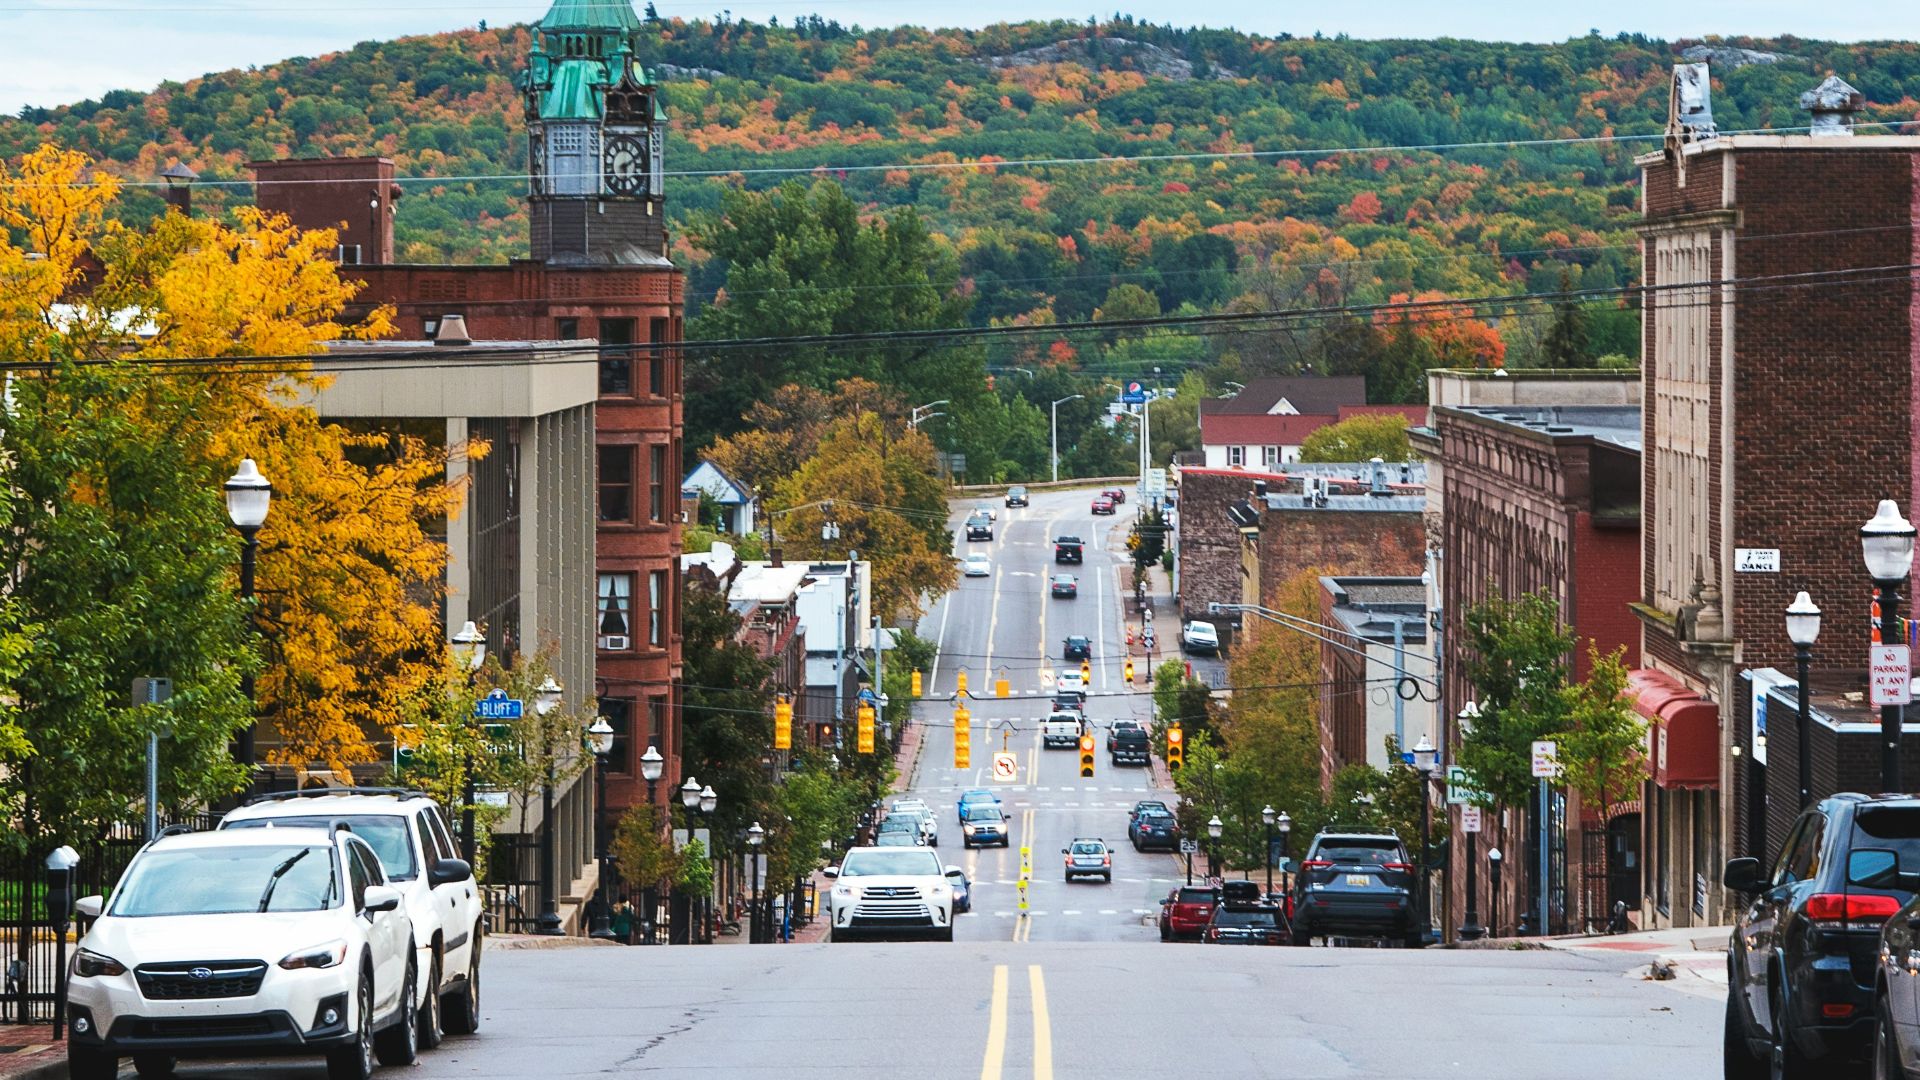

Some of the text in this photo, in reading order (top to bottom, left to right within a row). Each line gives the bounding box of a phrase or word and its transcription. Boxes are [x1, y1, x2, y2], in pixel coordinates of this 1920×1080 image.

[1884, 653, 1897, 662] NO
[1874, 664, 1908, 673] PARKING
[1875, 676, 1905, 685] AT ANY
[1882, 688, 1900, 697] TIME
[482, 702, 512, 716] BLUFF
[1182, 841, 1197, 851] 25
